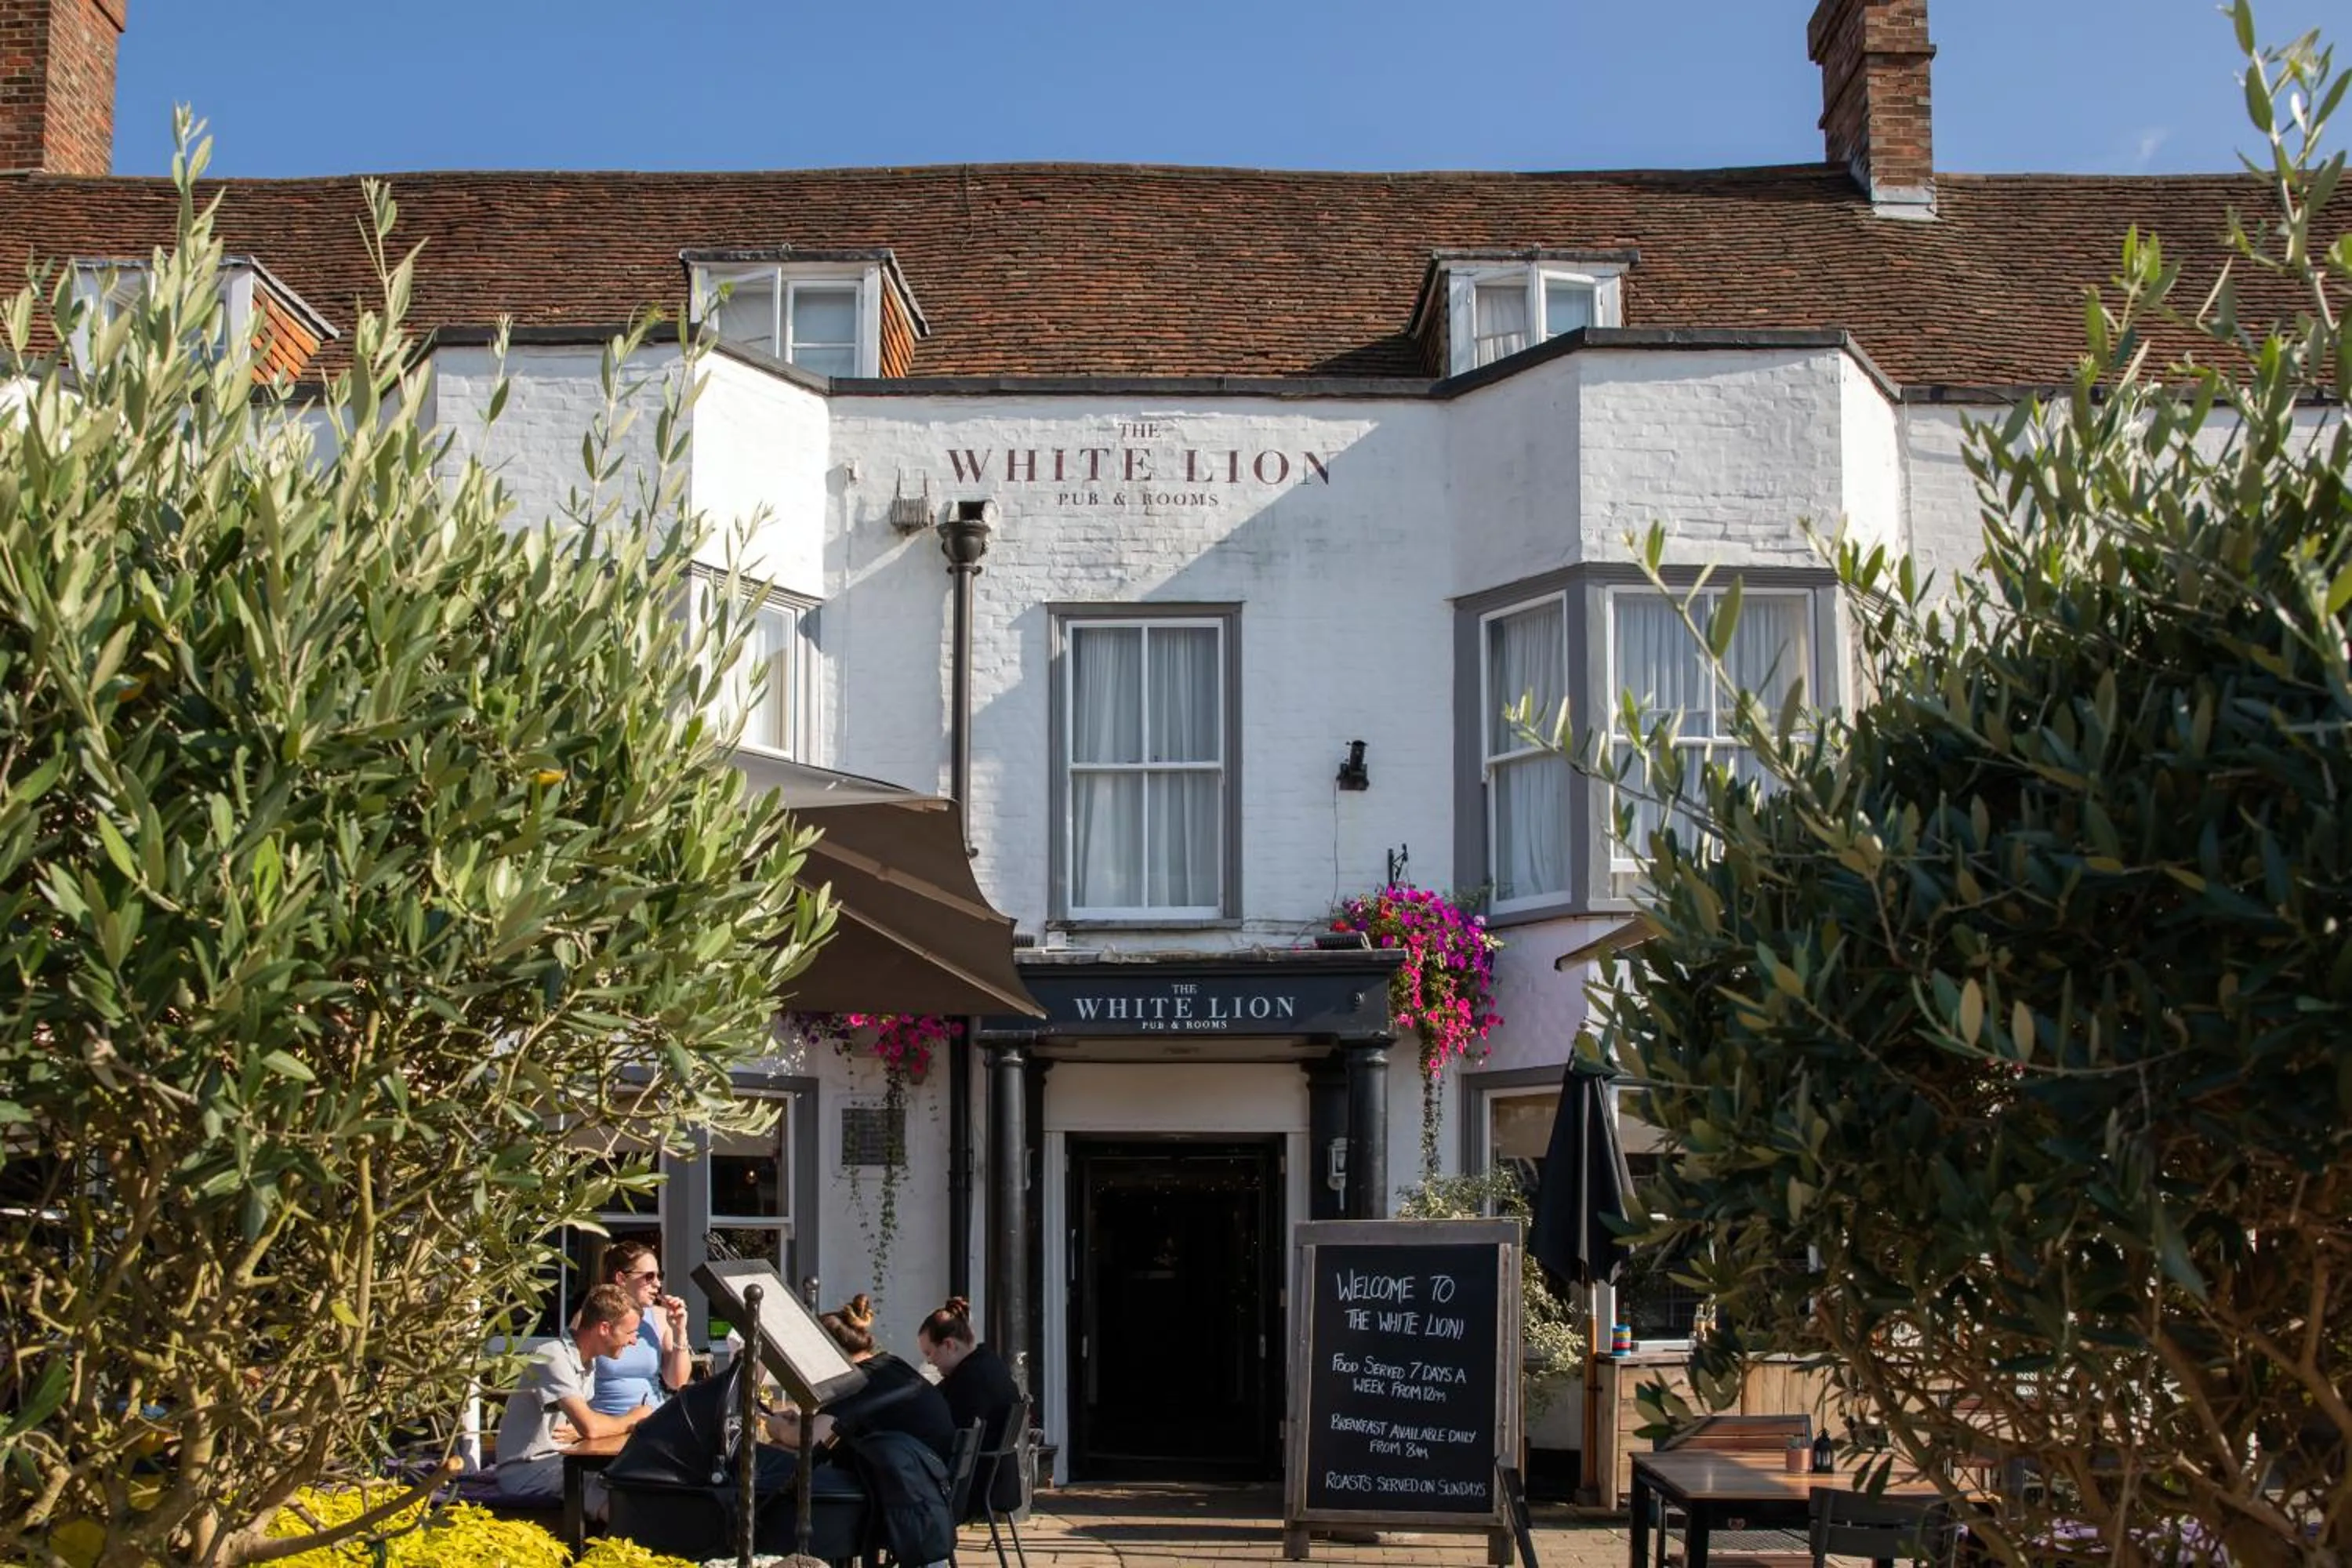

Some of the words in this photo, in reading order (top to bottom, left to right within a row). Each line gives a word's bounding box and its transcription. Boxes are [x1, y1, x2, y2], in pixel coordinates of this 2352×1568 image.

[1117, 423, 1162, 439] THE
[946, 448, 1152, 485] WHITE
[1185, 448, 1334, 486] LION
[1058, 493, 1098, 506] PUB
[1113, 493, 1127, 506] &
[1142, 493, 1219, 506] ROOMS
[1172, 984, 1197, 995] THE
[1074, 998, 1193, 1019] WHITE
[1209, 996, 1296, 1018] LION
[1142, 1021, 1164, 1030] PUB
[1171, 1021, 1178, 1029] &
[1186, 1020, 1228, 1029] ROOMS
[1336, 1269, 1415, 1304] WELCOME
[1430, 1275, 1455, 1303] TO
[1345, 1308, 1370, 1330] THE
[1377, 1311, 1420, 1335] WHITE
[1364, 1355, 1405, 1380] SERVED
[1410, 1362, 1422, 1379] 7
[1422, 1365, 1451, 1382] DAYS
[1454, 1368, 1467, 1384] A
[1353, 1377, 1385, 1395] WEEK
[1391, 1381, 1421, 1401] FROM
[1388, 1424, 1447, 1442] AVAILABLE
[1448, 1429, 1477, 1443] DAILY
[1370, 1439, 1400, 1456] FROM
[1326, 1470, 1372, 1493] ROASTS
[1377, 1476, 1419, 1493] SERVED
[1420, 1479, 1436, 1494] ON
[1437, 1479, 1486, 1497] SUNDAYS
